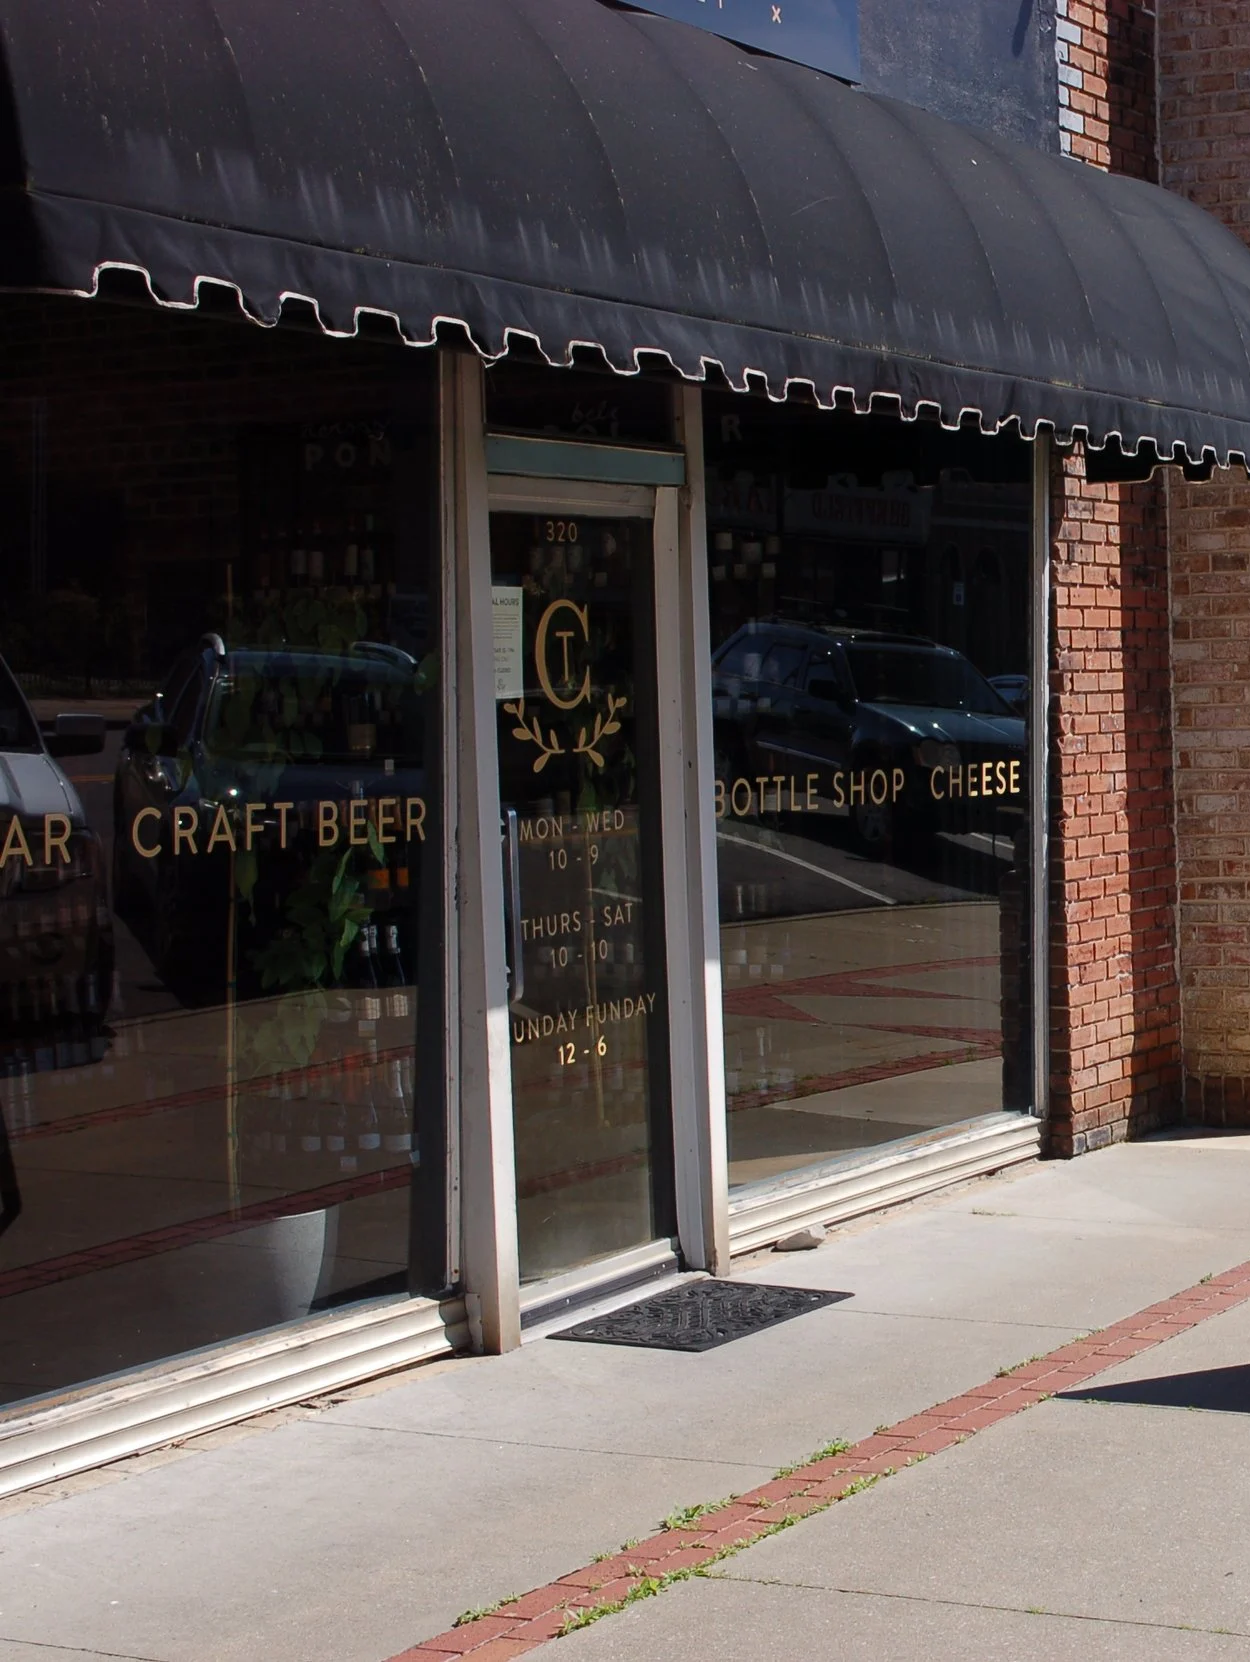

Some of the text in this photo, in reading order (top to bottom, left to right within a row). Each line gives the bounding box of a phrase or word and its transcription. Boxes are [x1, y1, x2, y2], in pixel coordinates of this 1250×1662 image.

[546, 521, 578, 543] 320
[715, 767, 905, 818] BOTTLE SHOP
[930, 760, 1020, 800] CHEESE
[131, 802, 294, 858] CRAFT
[318, 797, 427, 847] BEER
[519, 815, 563, 842] MON
[585, 809, 625, 832] WED
[549, 849, 567, 871] 10
[590, 845, 599, 866] 9
[521, 910, 582, 941] THURS
[603, 902, 634, 927] SAT
[550, 946, 568, 969] 10
[591, 939, 608, 961] 10
[586, 992, 657, 1027] FUNDAY
[558, 1042, 576, 1066] 12
[597, 1034, 607, 1057] 6
